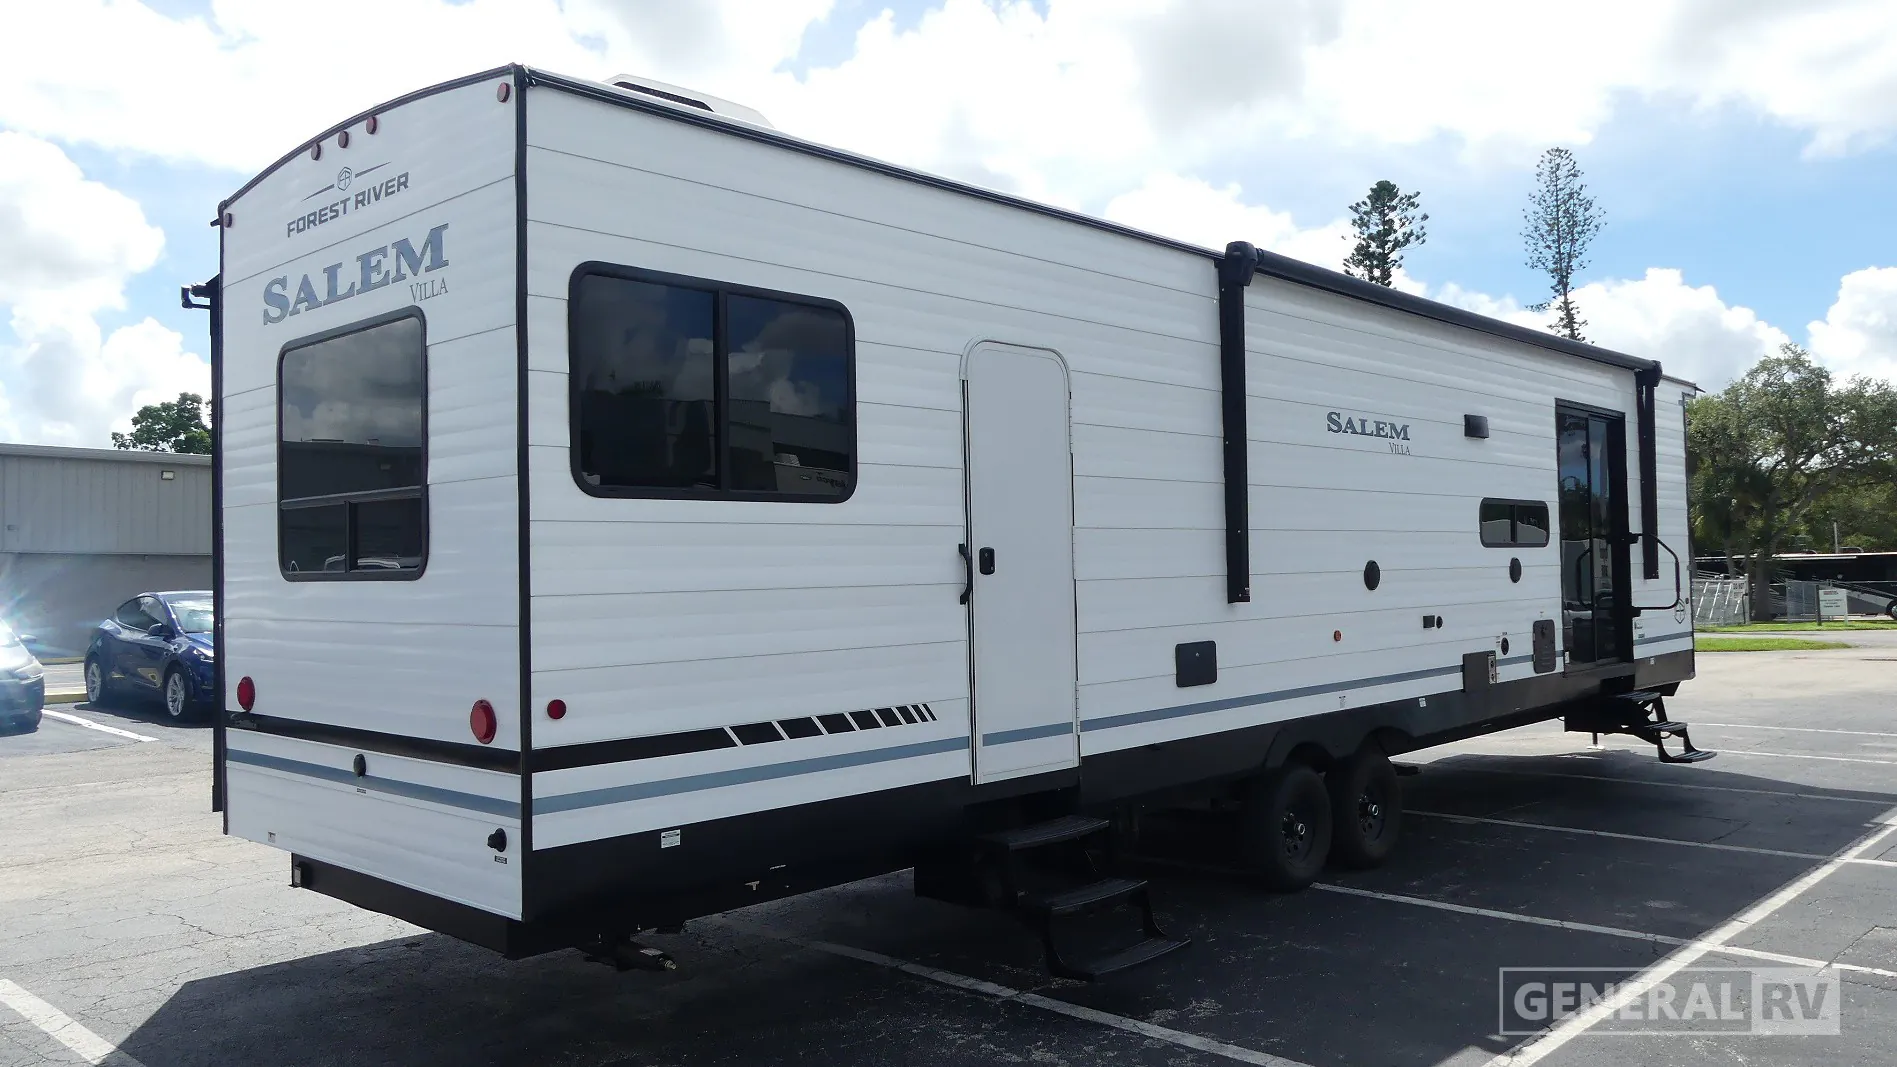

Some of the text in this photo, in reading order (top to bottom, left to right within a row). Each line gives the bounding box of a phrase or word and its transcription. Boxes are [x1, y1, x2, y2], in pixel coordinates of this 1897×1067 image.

[286, 171, 409, 238] FOREST RIVER
[262, 222, 450, 326] SALEM
[409, 276, 449, 303] VILLA
[1326, 411, 1411, 441] SALEM
[1388, 442, 1411, 456] VILLA
